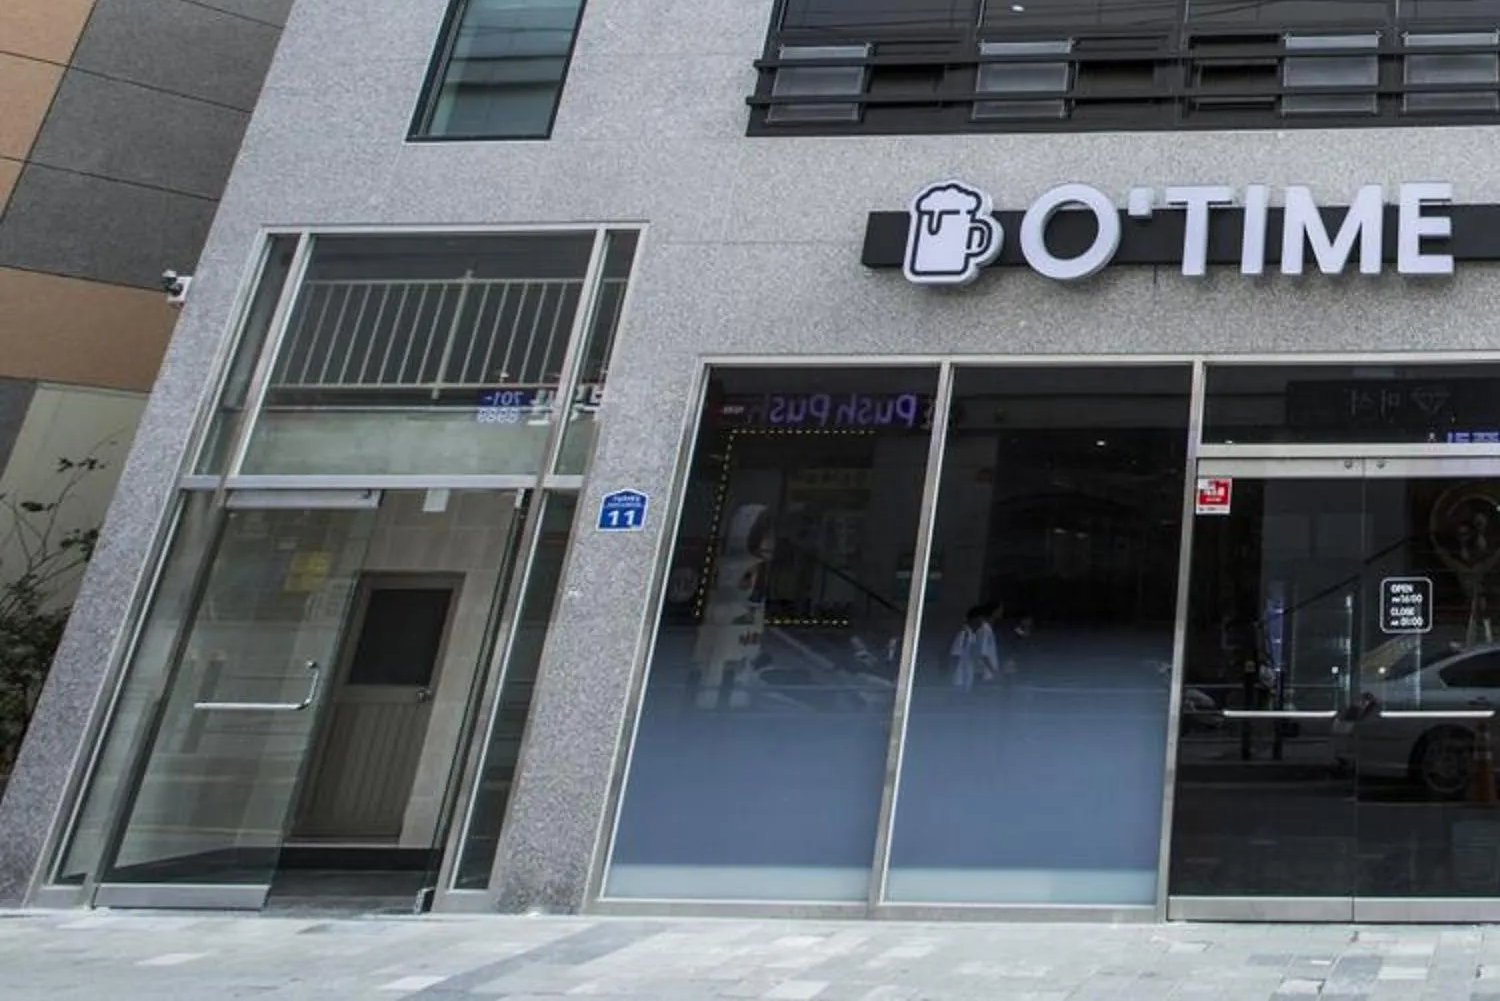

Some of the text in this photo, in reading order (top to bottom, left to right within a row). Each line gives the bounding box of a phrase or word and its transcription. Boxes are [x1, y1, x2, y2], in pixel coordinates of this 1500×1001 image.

[1019, 182, 1454, 280] O'TIME
[607, 510, 635, 526] 11
[1391, 584, 1414, 594] OPEN
[1390, 607, 1415, 616] CLOSE
